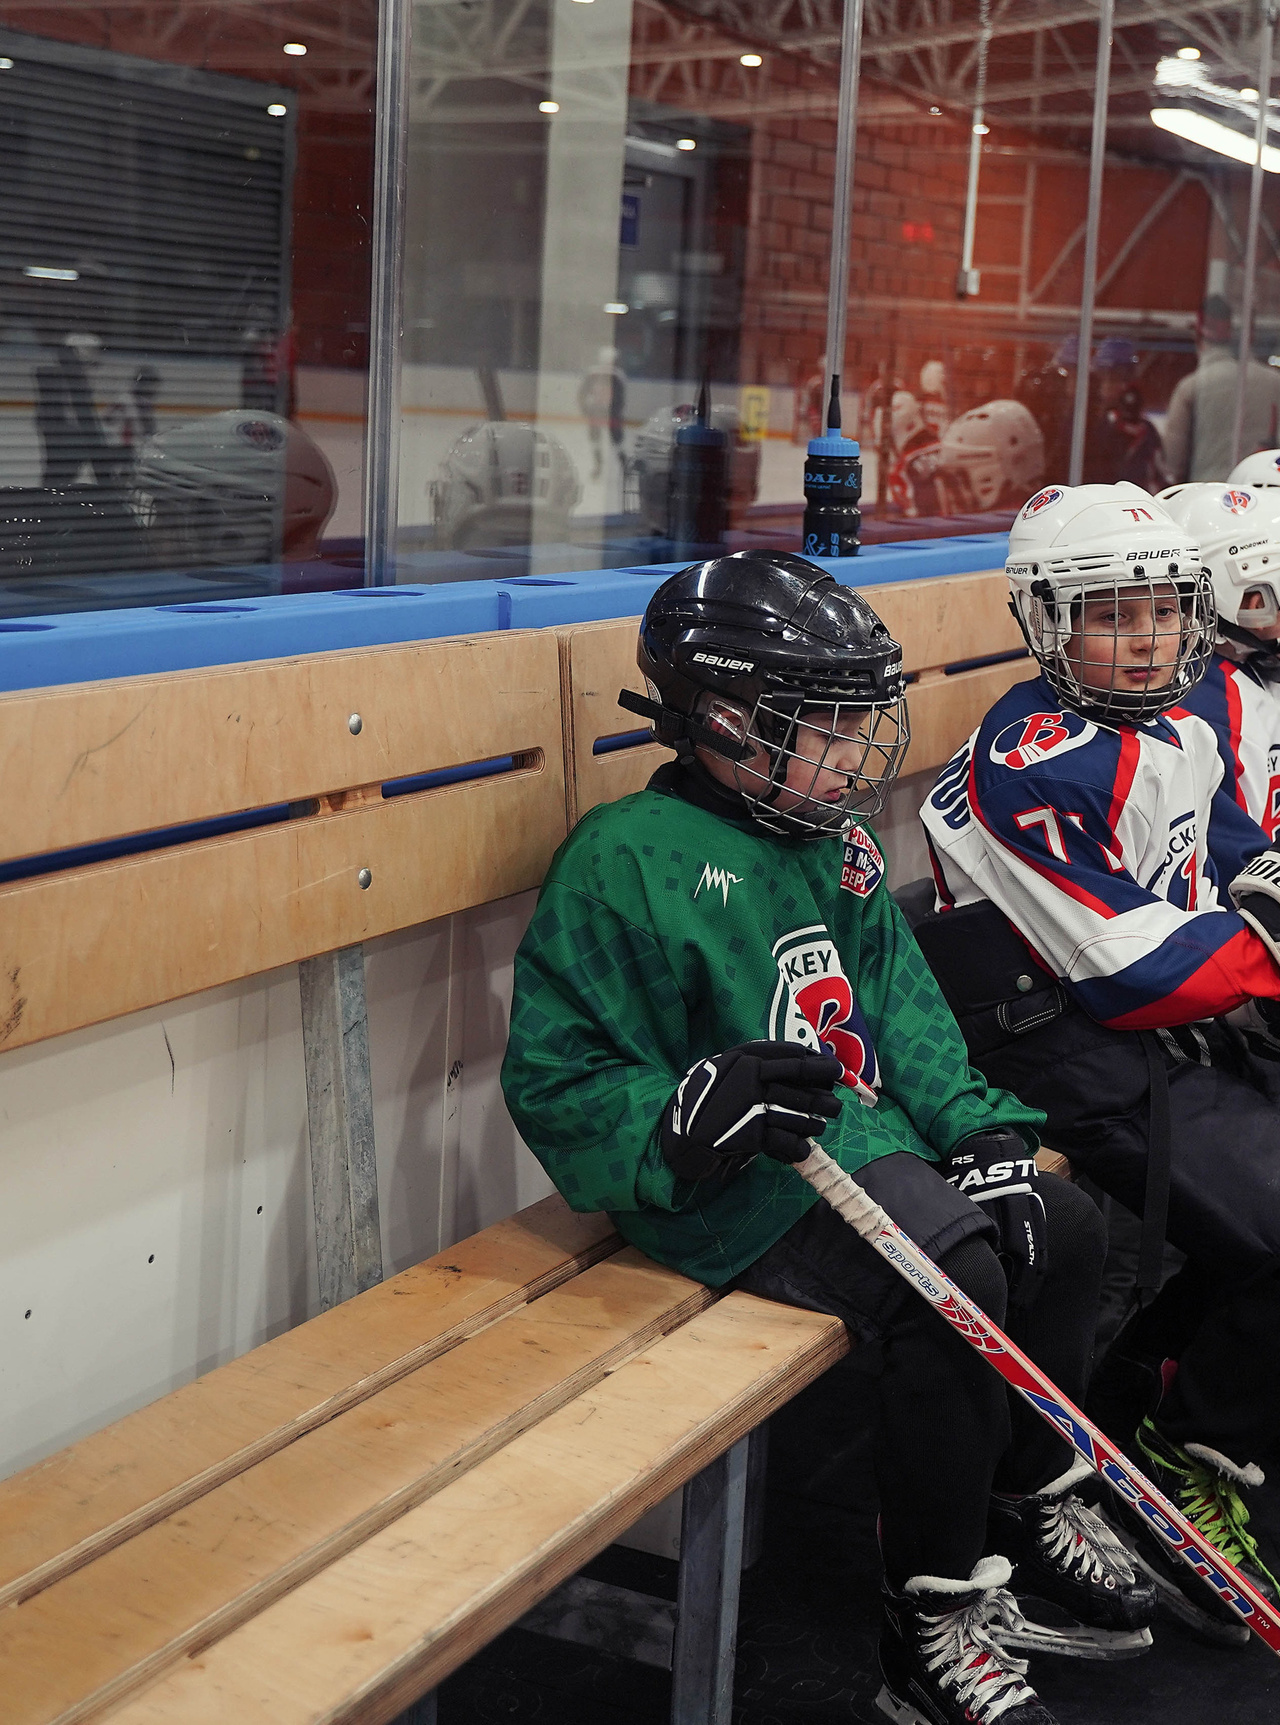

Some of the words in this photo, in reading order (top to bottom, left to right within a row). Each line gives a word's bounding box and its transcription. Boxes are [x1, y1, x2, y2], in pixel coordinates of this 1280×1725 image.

[1122, 508, 1155, 522] 71
[1240, 539, 1269, 551] NORDWAY
[1126, 549, 1181, 561] BAUER
[1006, 566, 1028, 575] BAUER
[692, 652, 755, 673] BAUER
[782, 950, 832, 985] KEY
[952, 1155, 974, 1165] RS
[1024, 1220, 1035, 1265] STEALTH
[881, 1240, 940, 1297] sports
[1019, 1386, 1256, 1619] Atom
